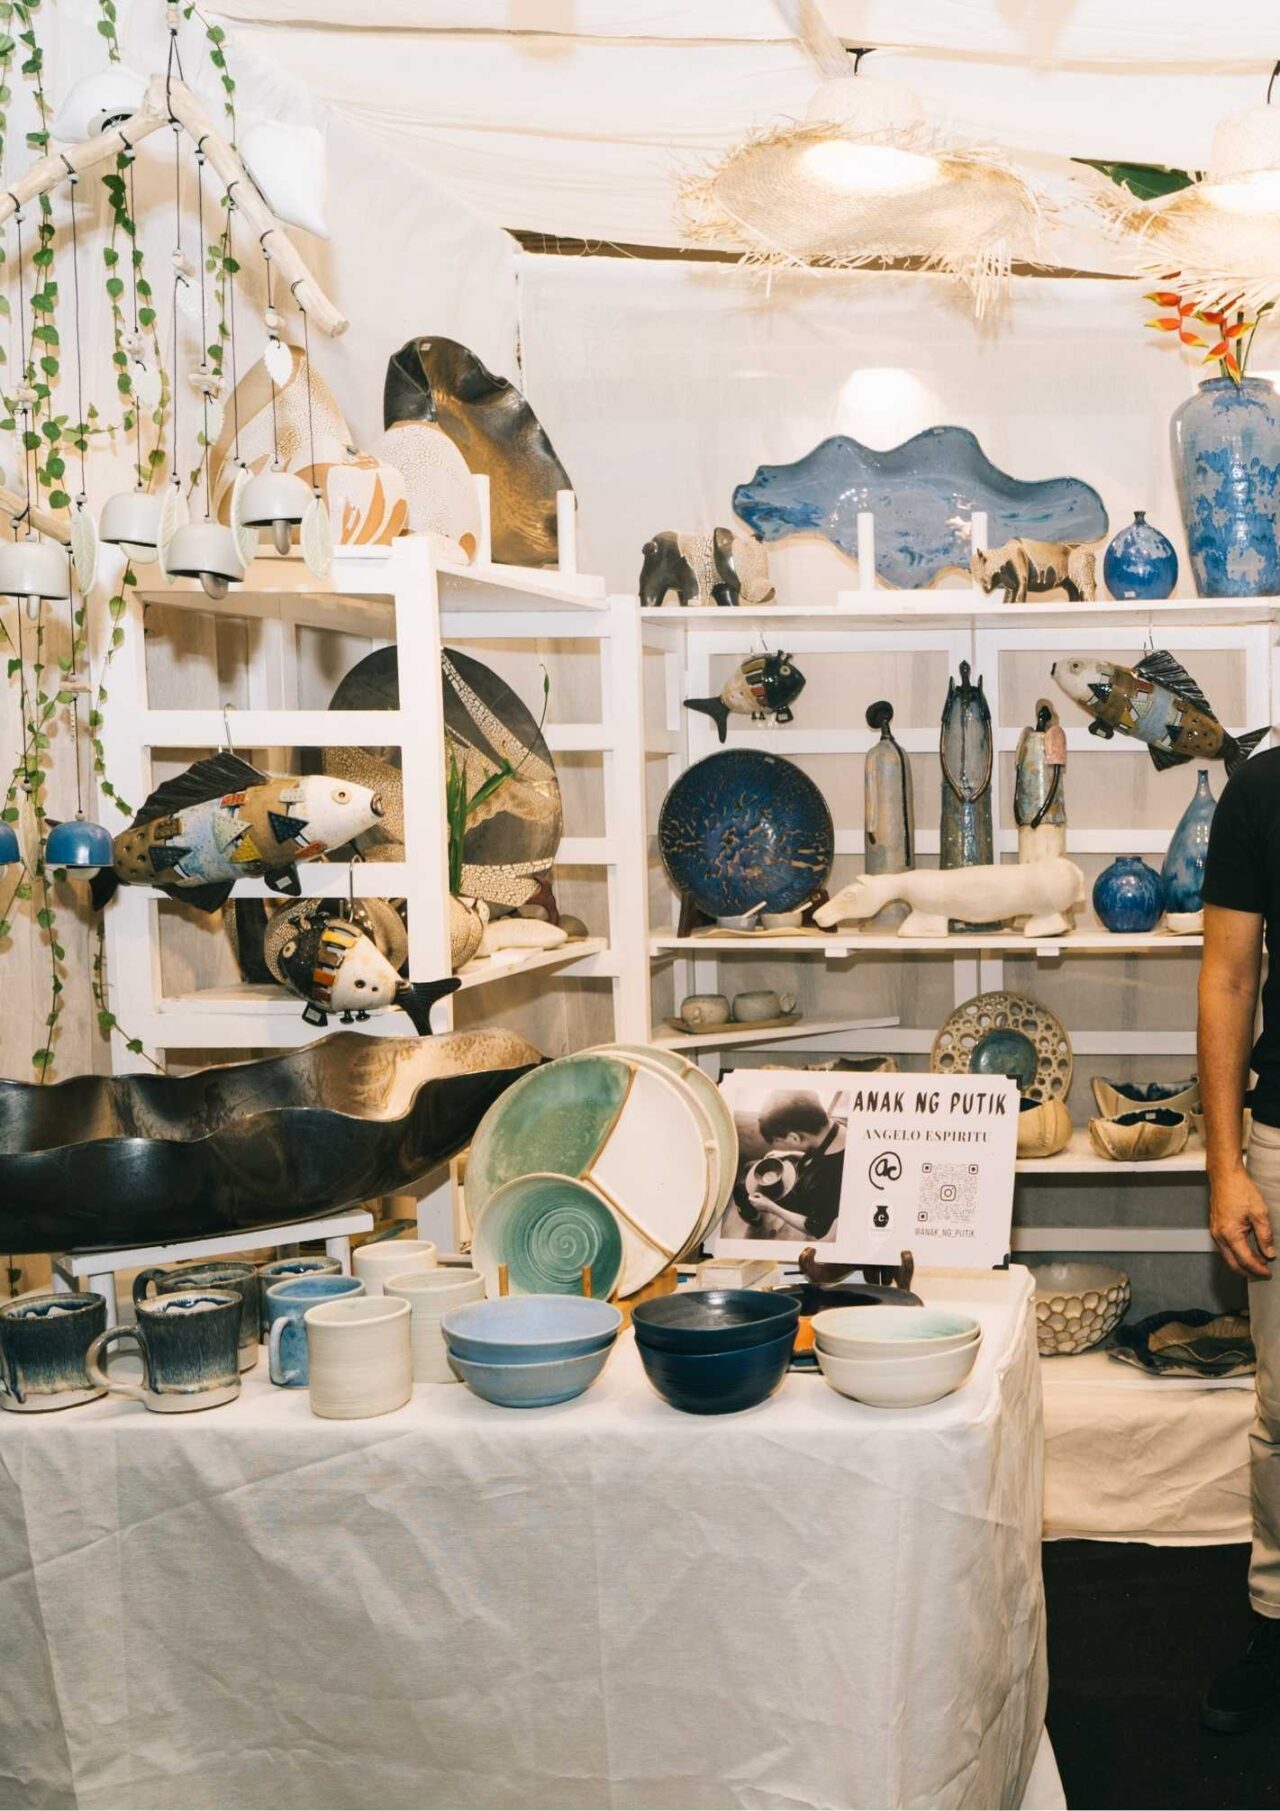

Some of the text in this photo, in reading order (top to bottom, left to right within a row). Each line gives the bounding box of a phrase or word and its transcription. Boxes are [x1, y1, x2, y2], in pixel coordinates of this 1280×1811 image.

[853, 1090, 1007, 1116] ANAK NG PUTIK
[864, 1129, 991, 1143] ANGELO ESPIRITU
